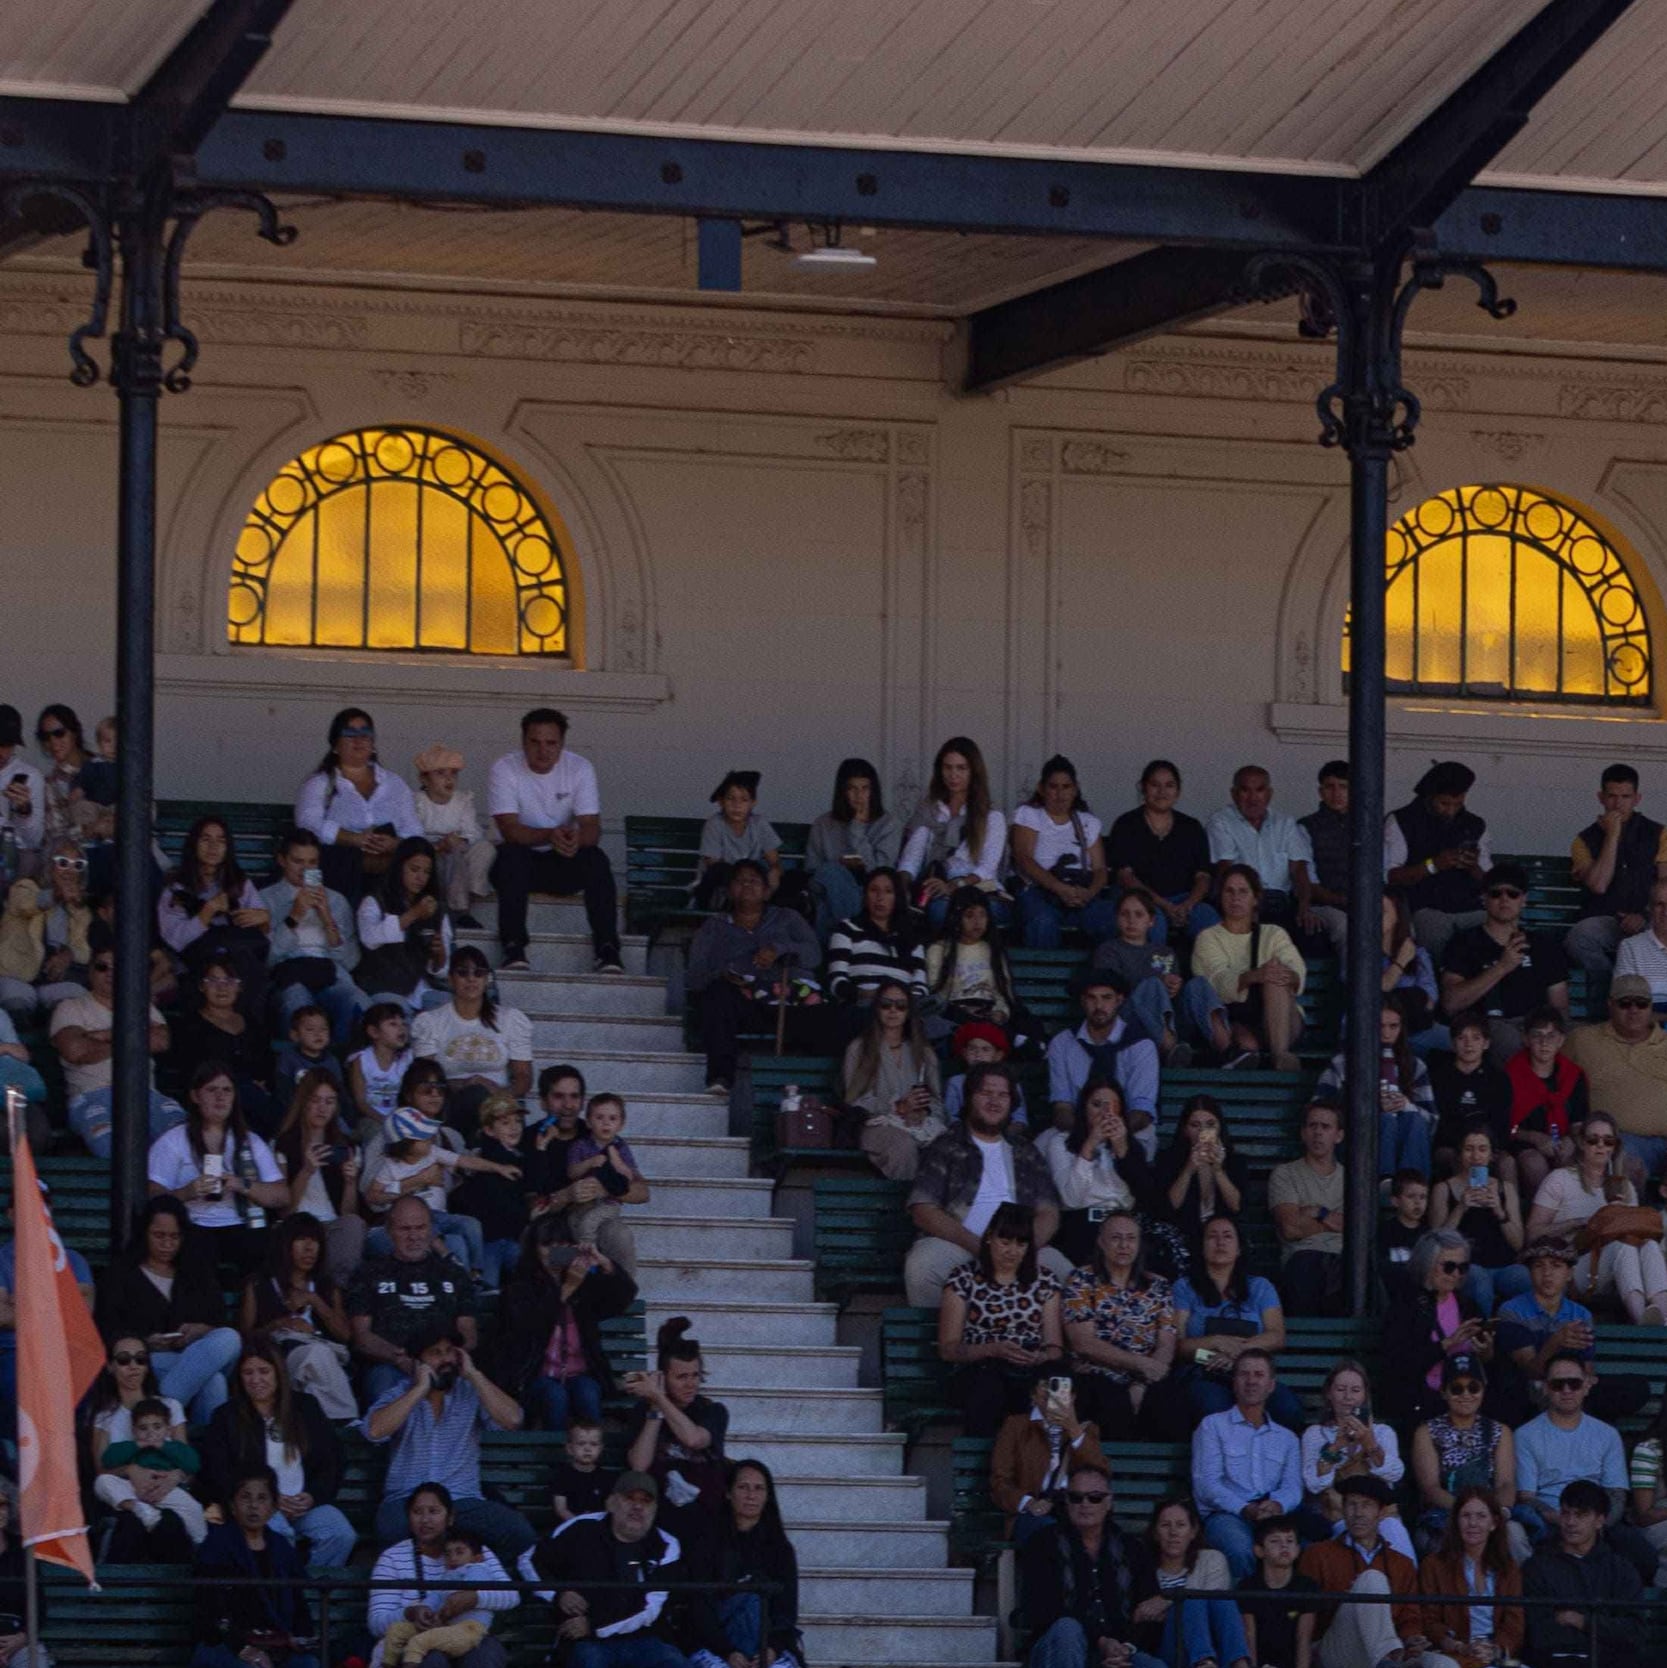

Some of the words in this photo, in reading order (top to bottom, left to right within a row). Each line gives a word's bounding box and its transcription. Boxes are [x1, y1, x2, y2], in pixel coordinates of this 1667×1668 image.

[377, 1281, 397, 1294] 21
[410, 1282, 429, 1294] 15
[442, 1282, 454, 1293] 9
